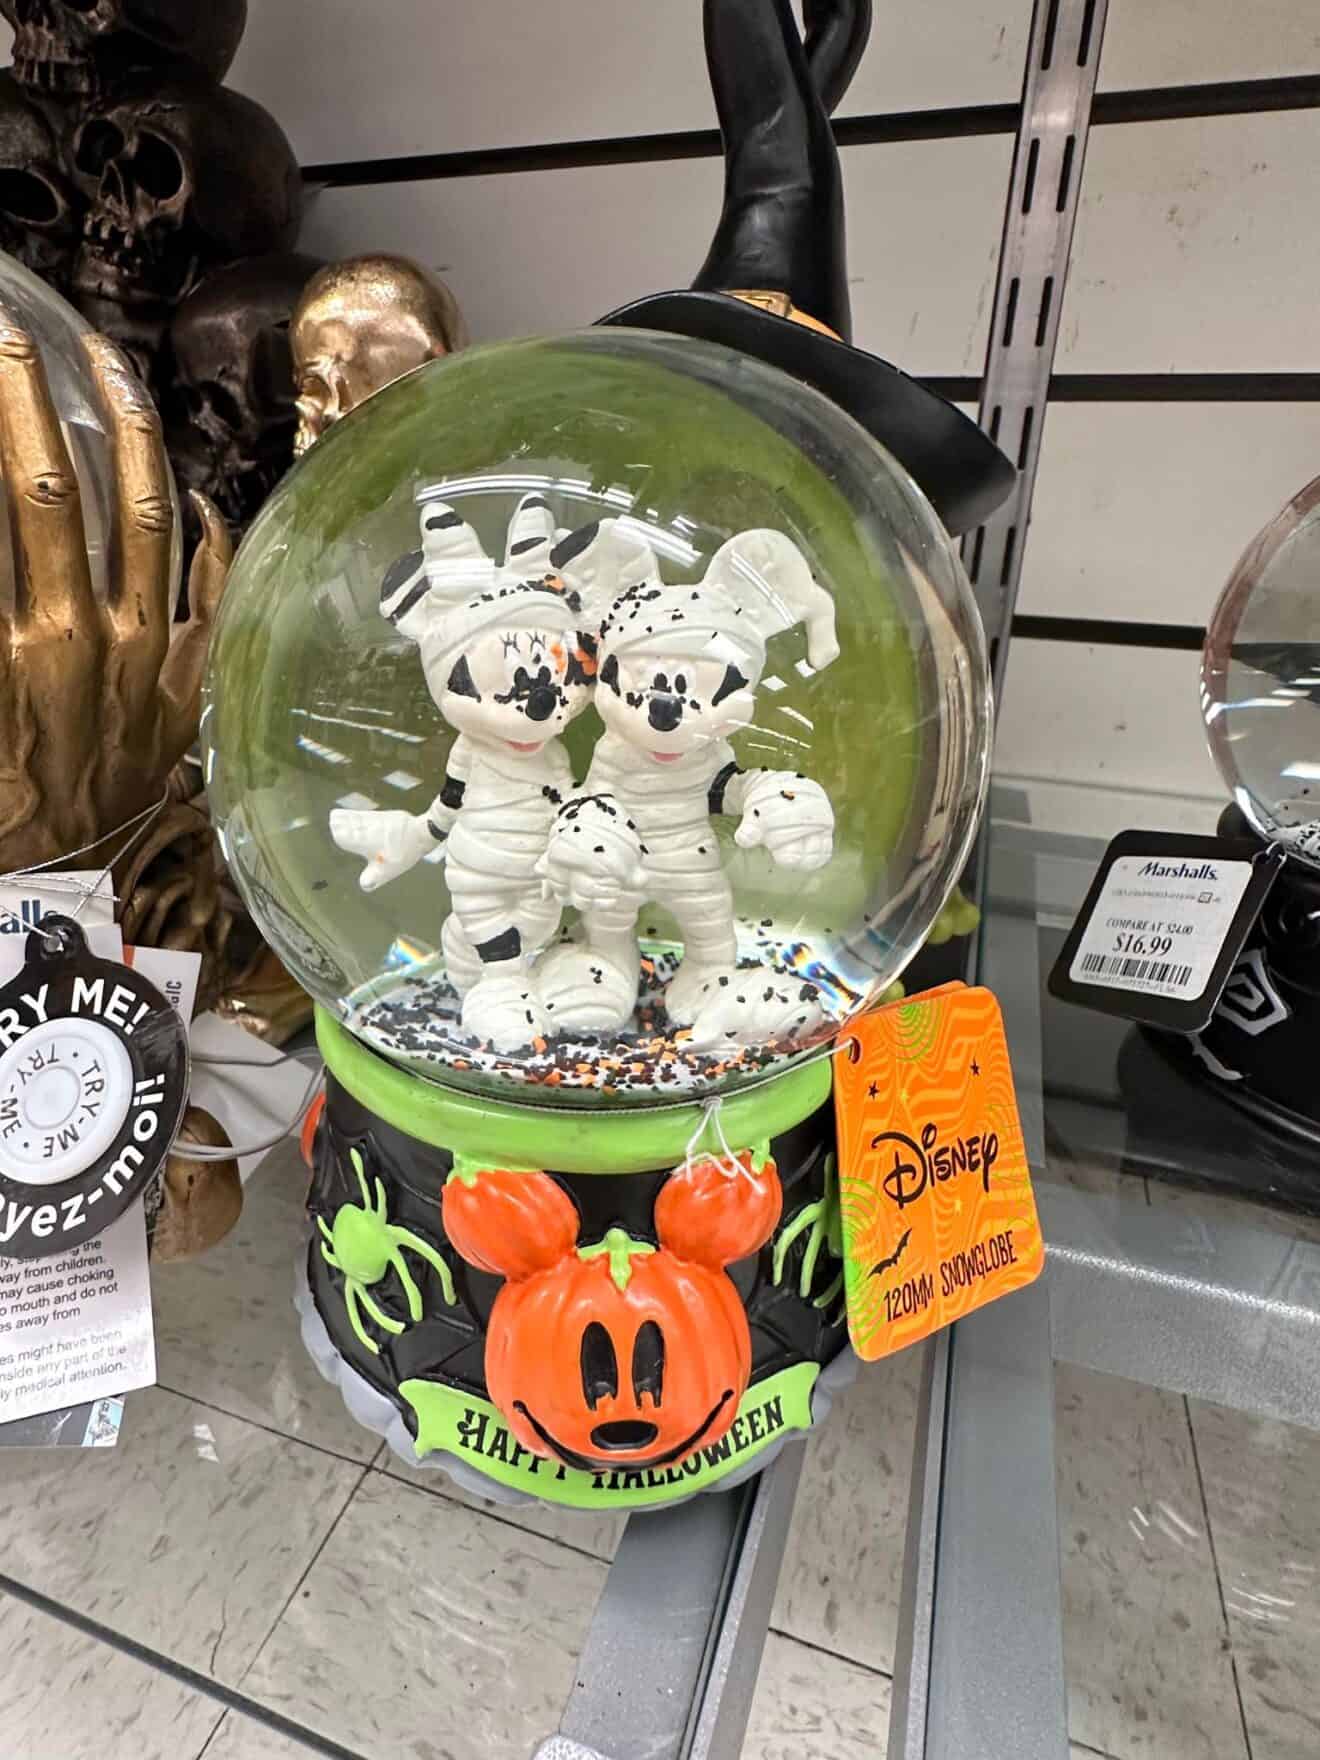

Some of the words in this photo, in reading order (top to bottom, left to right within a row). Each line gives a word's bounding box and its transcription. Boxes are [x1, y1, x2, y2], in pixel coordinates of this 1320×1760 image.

[0, 900, 57, 934] all
[1105, 917, 1149, 931] COMPARE
[1151, 919, 1163, 932] AT
[1112, 931, 1173, 957] $16.99
[71, 976, 151, 1035] ME!
[0, 1073, 166, 1242] yez-moi!
[83, 1240, 102, 1251] the
[24, 1266, 52, 1279] from
[26, 1280, 64, 1294] cause
[67, 1268, 114, 1286] choking
[883, 1272, 935, 1322] 120MM
[941, 1230, 1018, 1297] SNOWGLOBE
[11, 1296, 50, 1314] mouth
[54, 1291, 77, 1305] and
[80, 1288, 96, 1299] do
[99, 1282, 118, 1295] not
[16, 1314, 49, 1329] away
[53, 1306, 80, 1321] from
[18, 1342, 53, 1360] might
[57, 1337, 87, 1352] have
[64, 1353, 88, 1370] part
